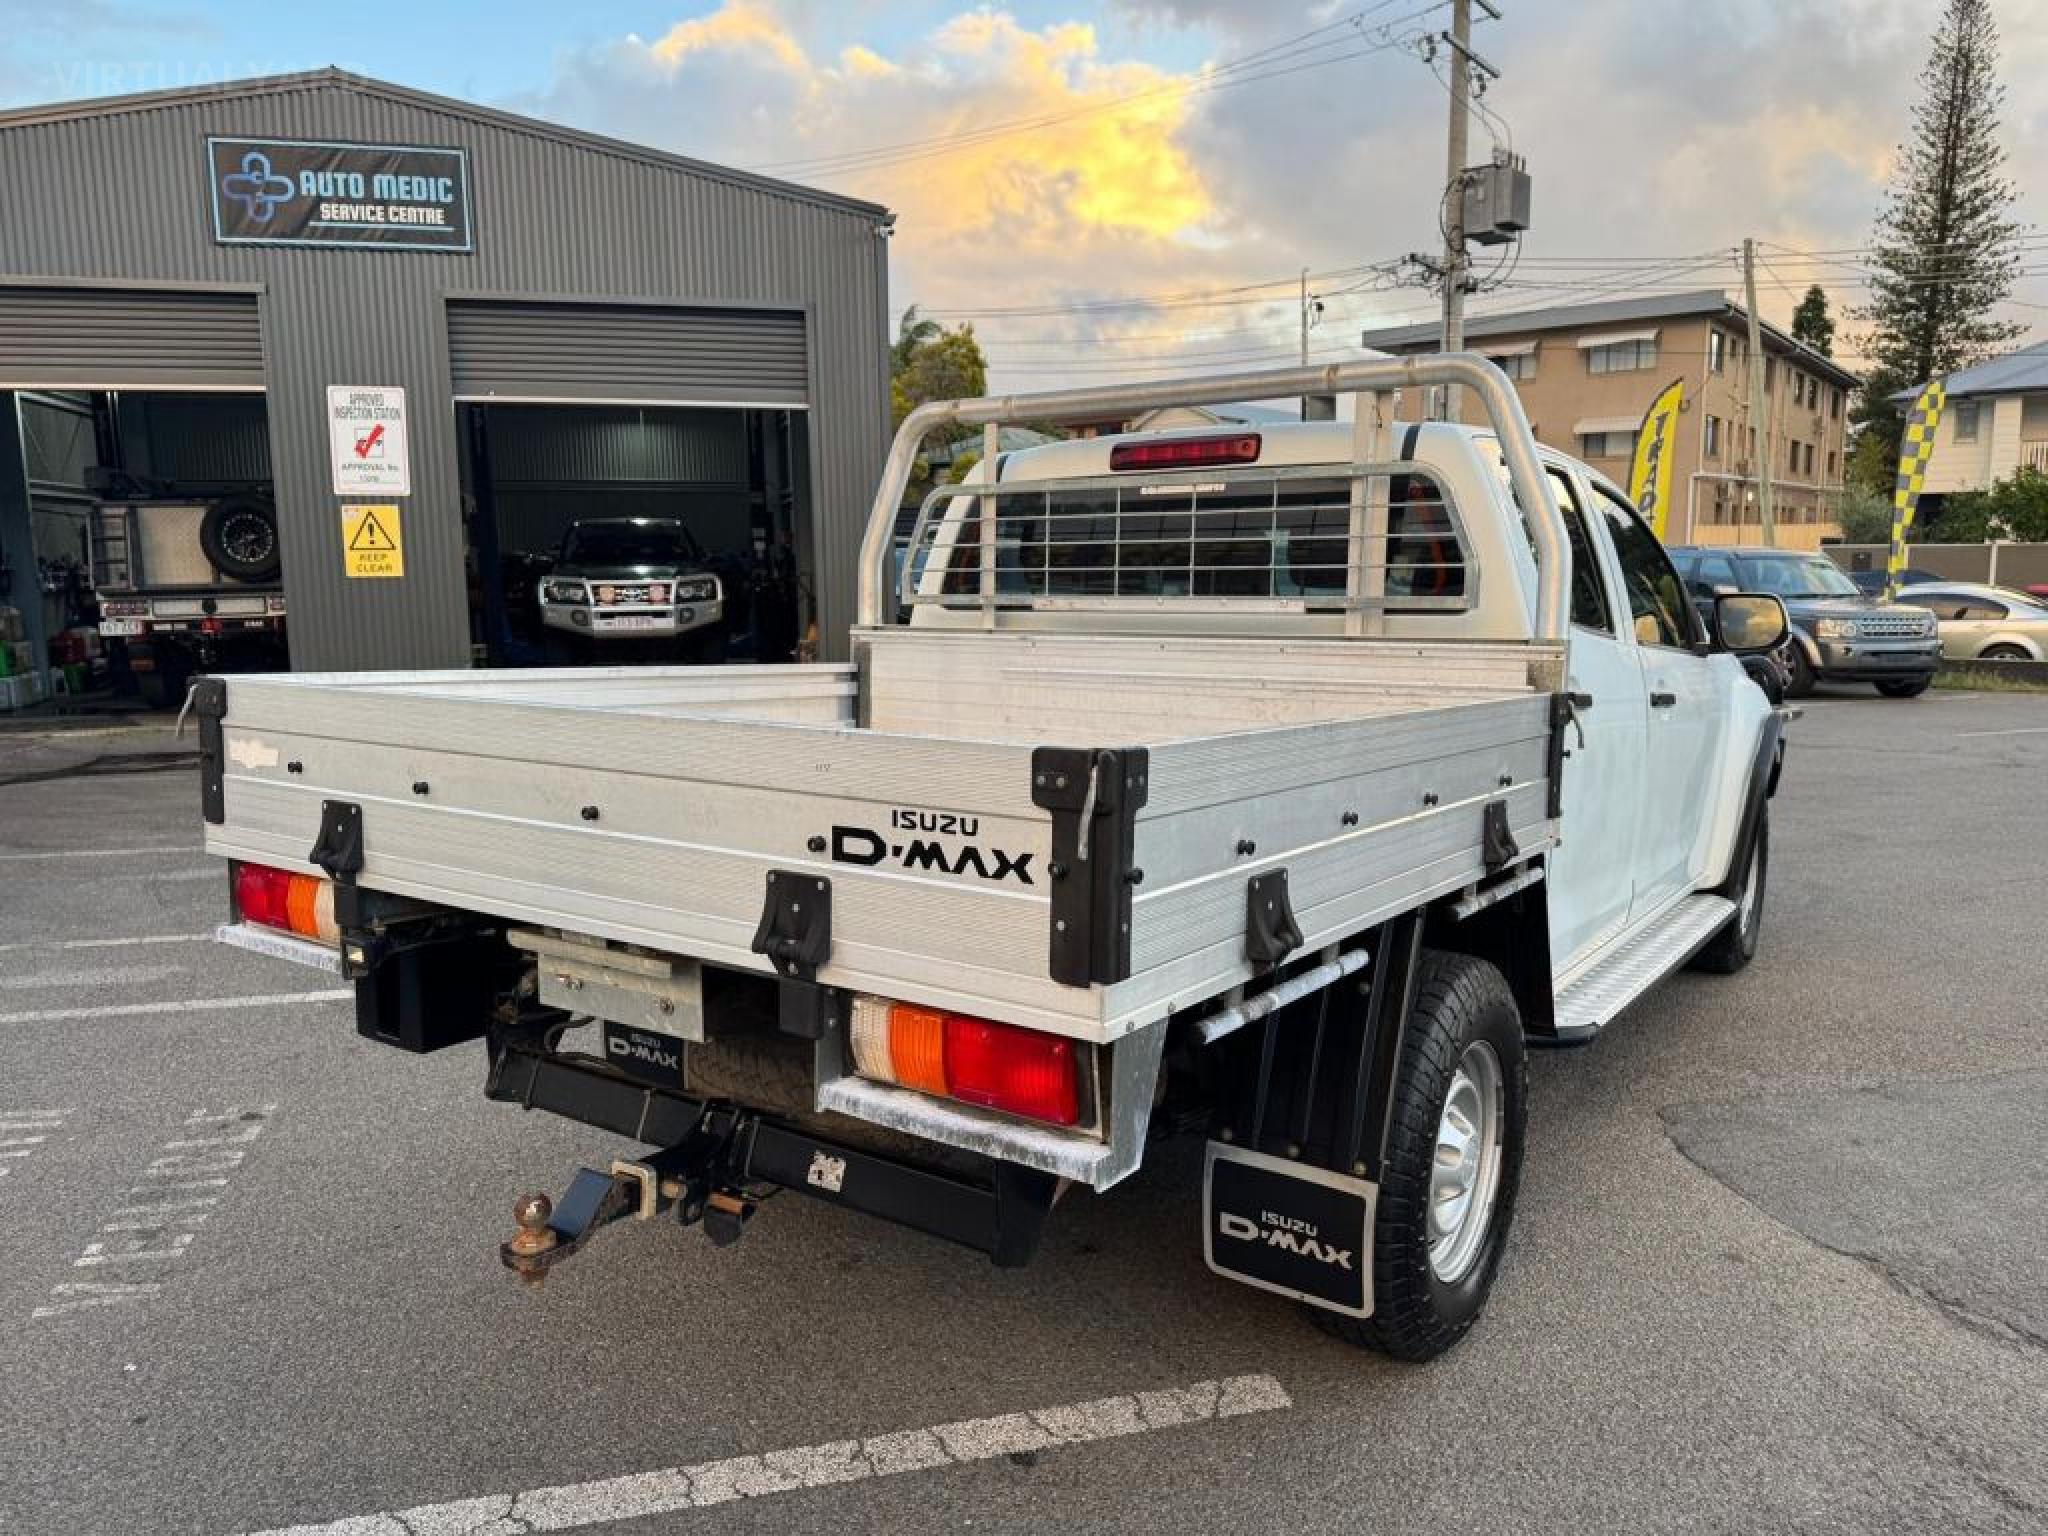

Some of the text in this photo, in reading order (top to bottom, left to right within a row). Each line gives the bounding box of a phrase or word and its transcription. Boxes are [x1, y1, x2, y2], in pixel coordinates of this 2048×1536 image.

[300, 170, 453, 203] AUTO MEDIC
[320, 202, 445, 225] SERVICE CENTRE
[349, 393, 385, 406] APPROVED
[335, 404, 401, 420] INSPECTION STATION
[359, 552, 389, 562] KEEP
[355, 563, 393, 573] CLEAR
[891, 809, 979, 836] ISUZU
[1261, 1210, 1319, 1237] ISUZU
